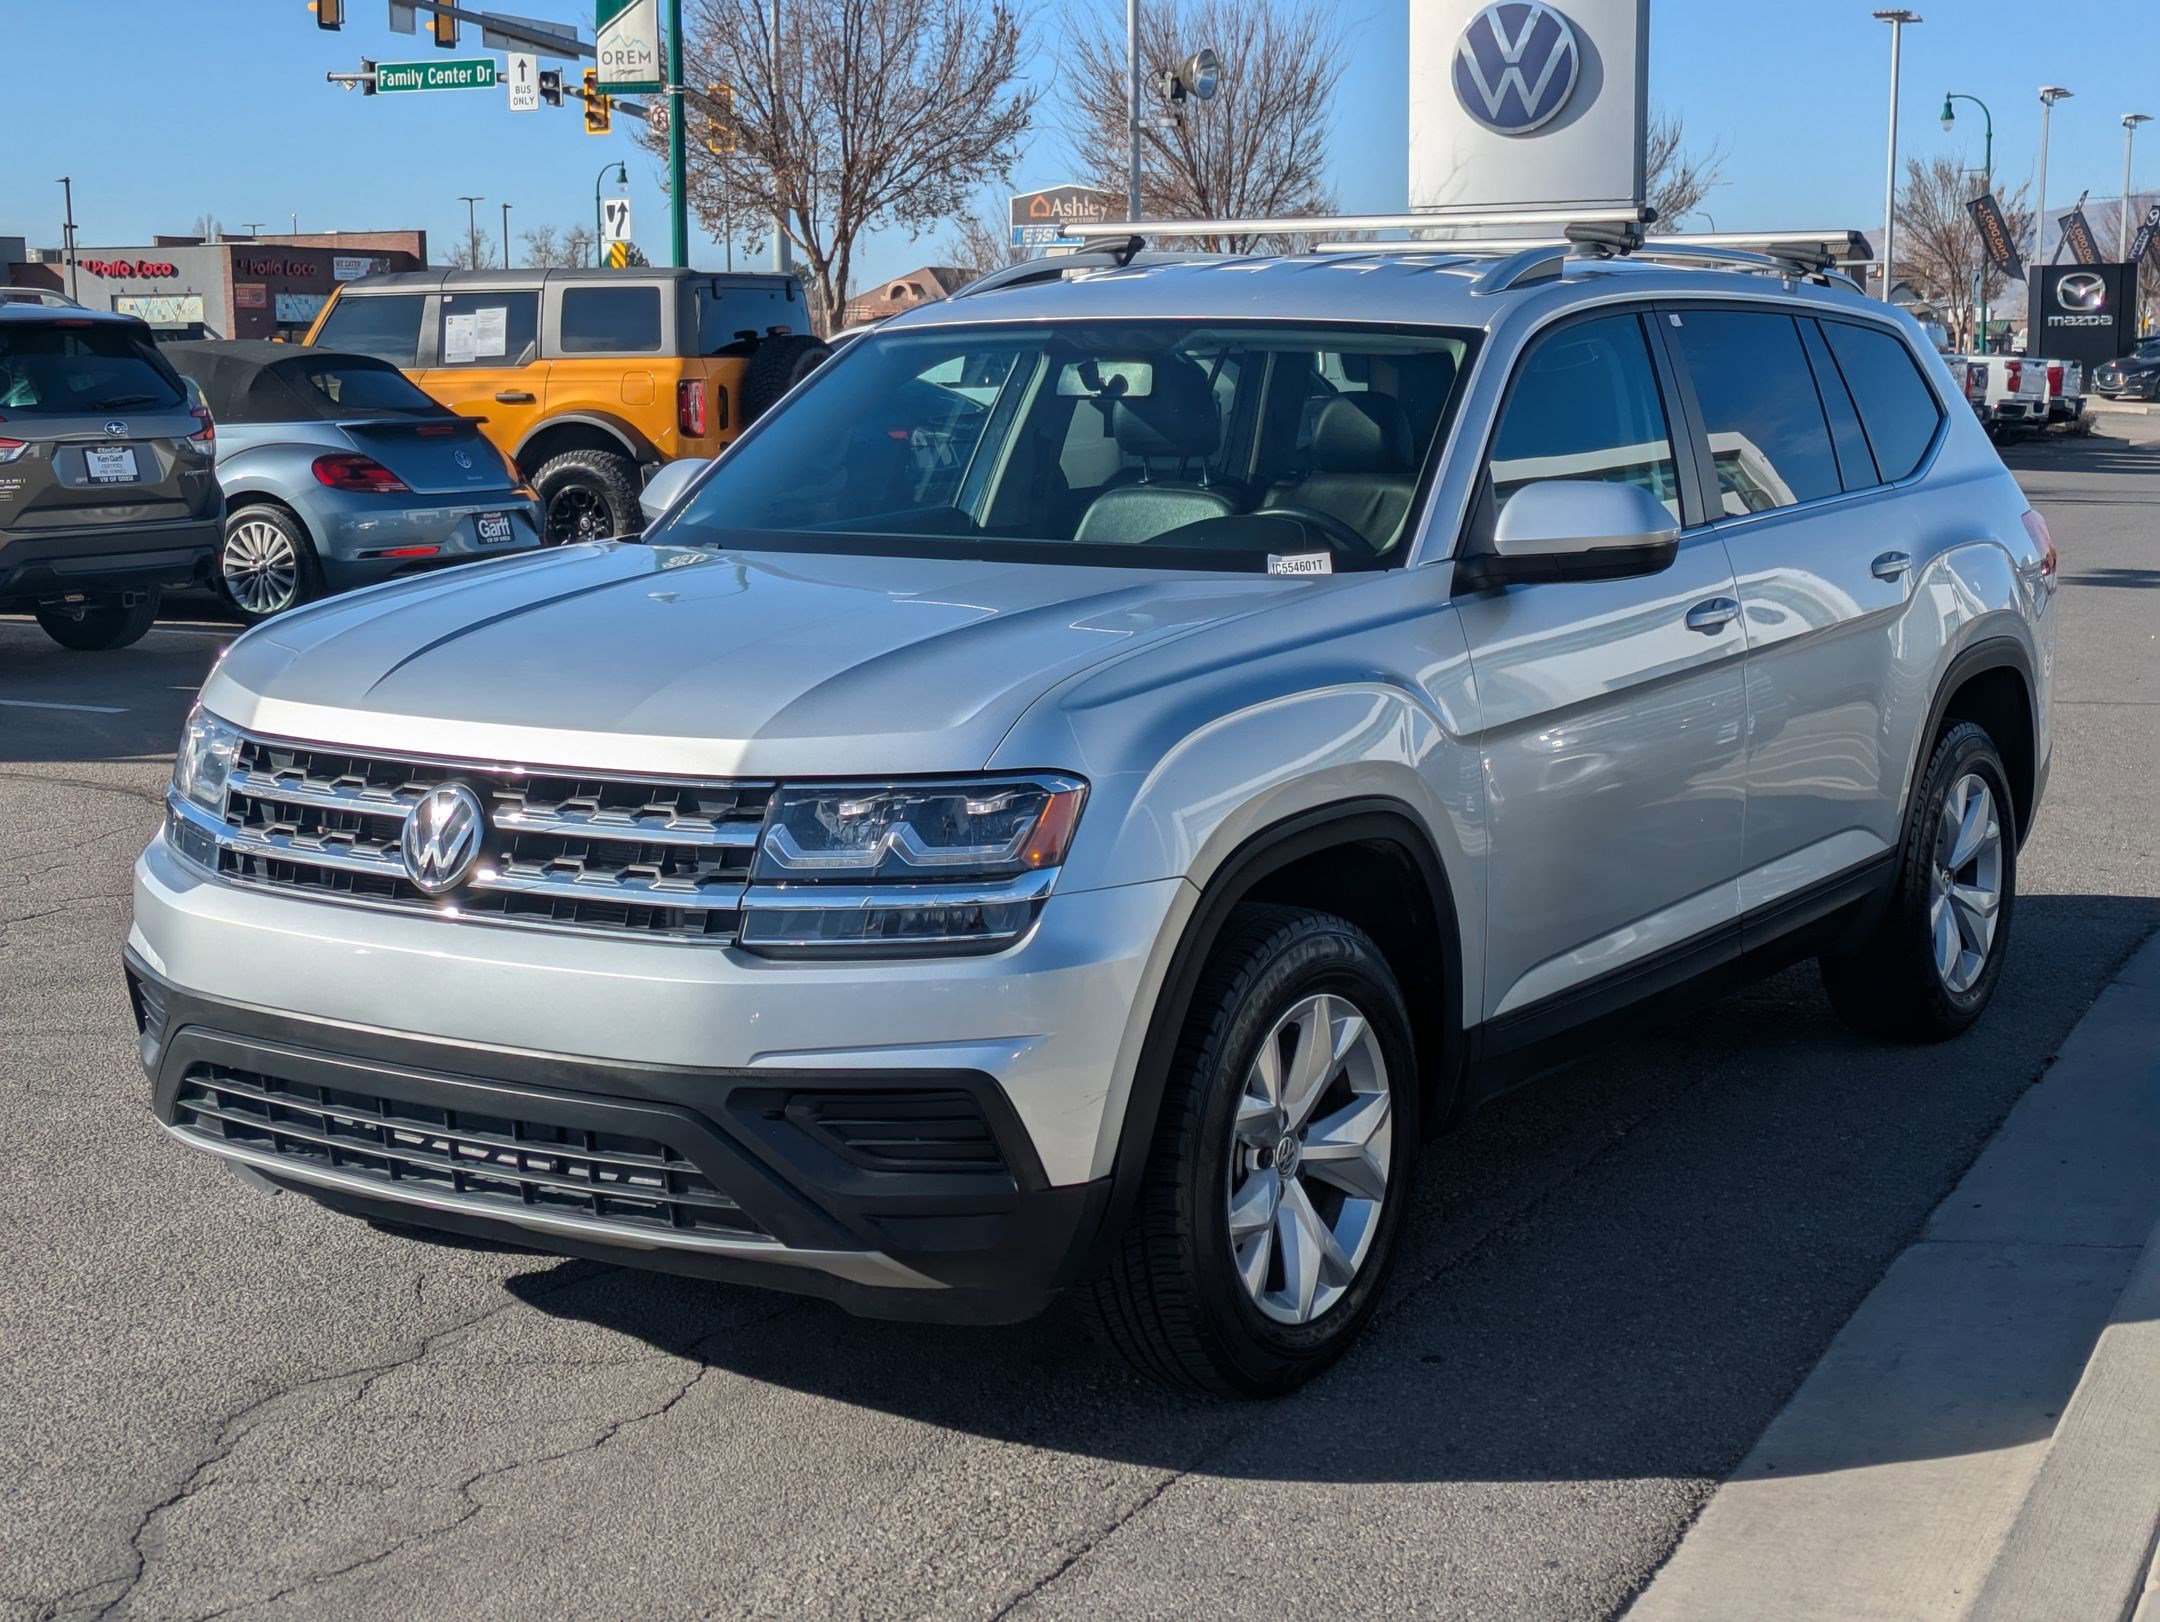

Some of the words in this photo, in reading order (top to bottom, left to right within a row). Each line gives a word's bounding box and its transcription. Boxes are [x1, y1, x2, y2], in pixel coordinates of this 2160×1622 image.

[601, 50, 652, 65] OREM
[379, 69, 424, 89] Family
[427, 67, 473, 85] Center
[476, 65, 492, 83] Dr
[515, 85, 532, 95] BUS
[512, 96, 535, 106] ONLY
[1050, 195, 1108, 222] Ashley
[92, 260, 130, 277] Pollo
[134, 260, 173, 277] Loco
[249, 259, 281, 276] Pollo
[286, 260, 317, 276] Loco
[479, 517, 510, 537] Garff
